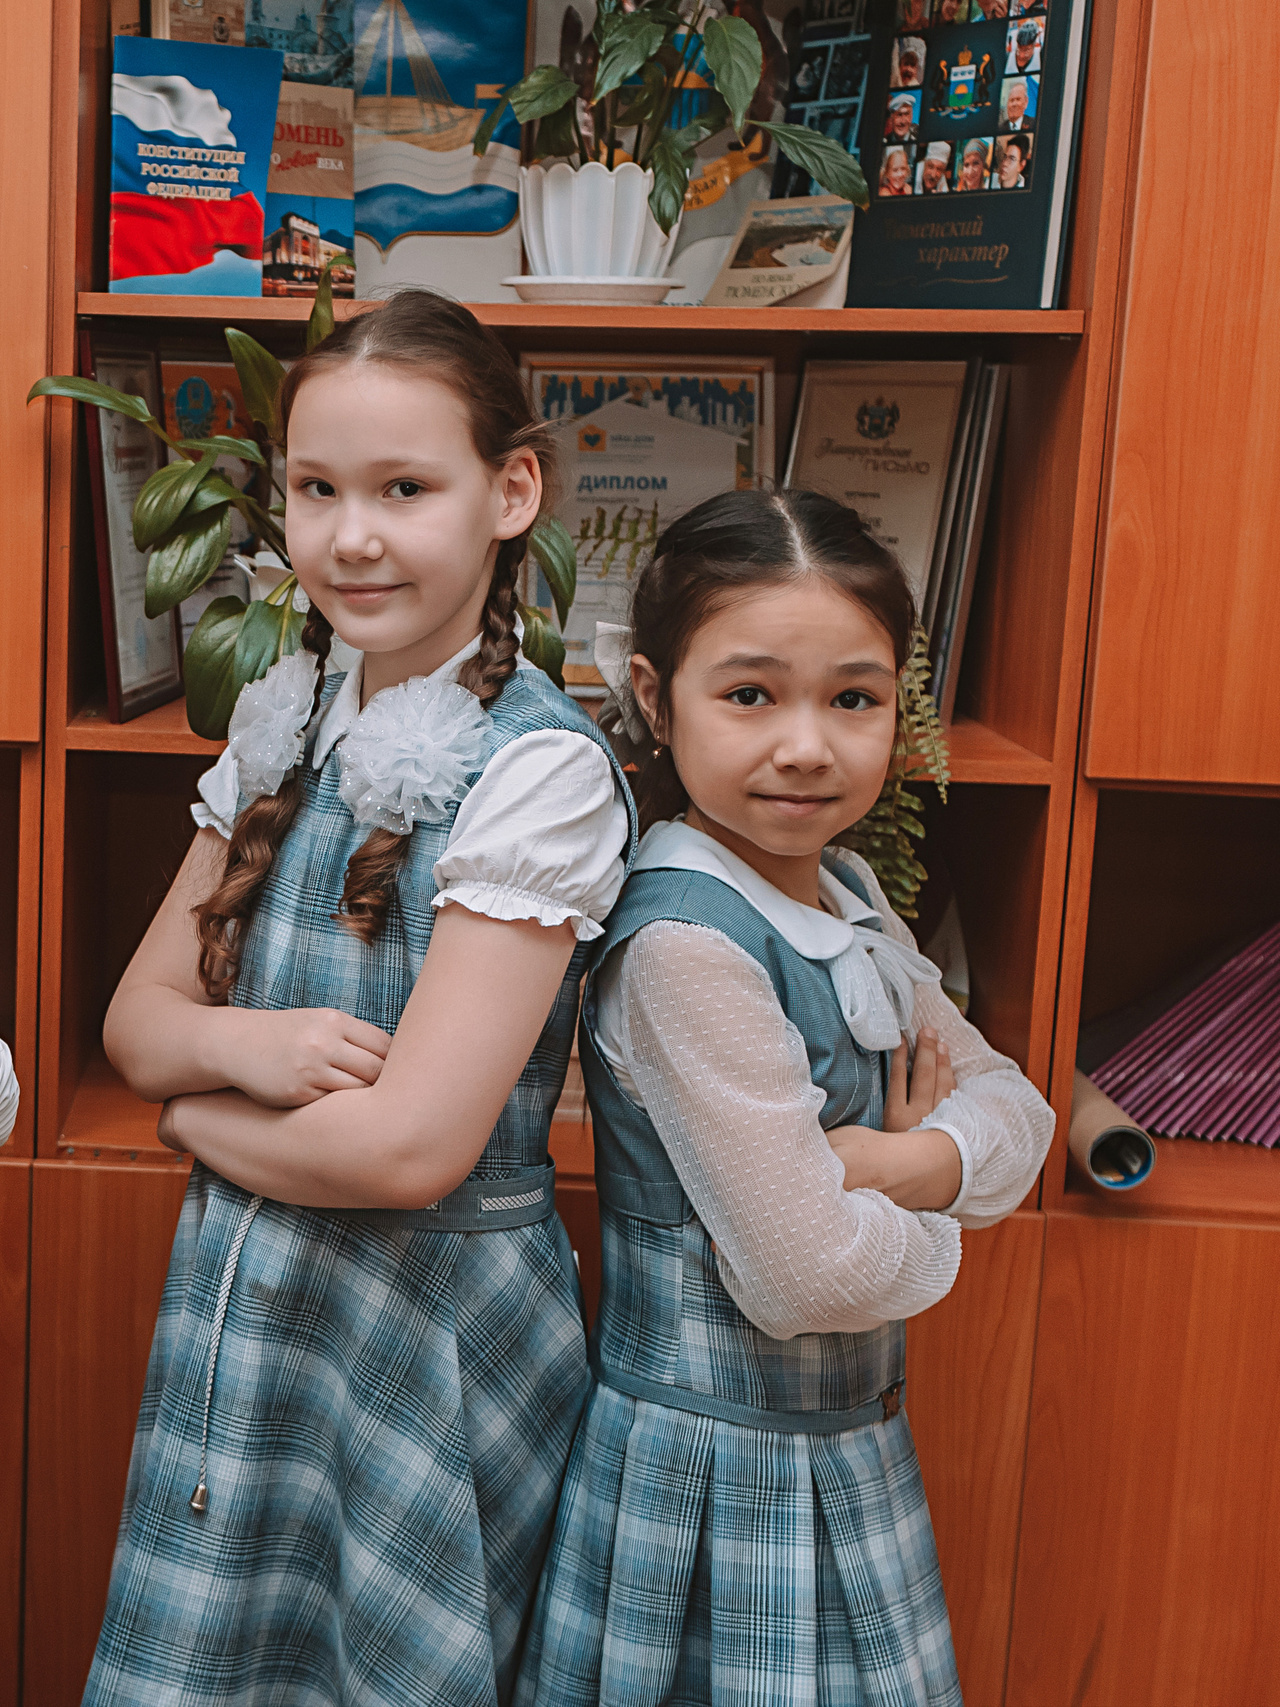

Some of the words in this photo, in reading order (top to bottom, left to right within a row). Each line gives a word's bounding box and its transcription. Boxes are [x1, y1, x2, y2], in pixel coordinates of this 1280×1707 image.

[274, 122, 344, 148] МЕНЬ
[136, 143, 246, 165] КОНСТИТУЦИЯ
[317, 157, 344, 171] ВЕКА
[140, 162, 240, 183] РОССИЙСКОЙ
[146, 181, 231, 201] ФЕДЕРАЦИИ
[916, 242, 1010, 271] характер
[577, 475, 668, 493] ДИПЛОМ
